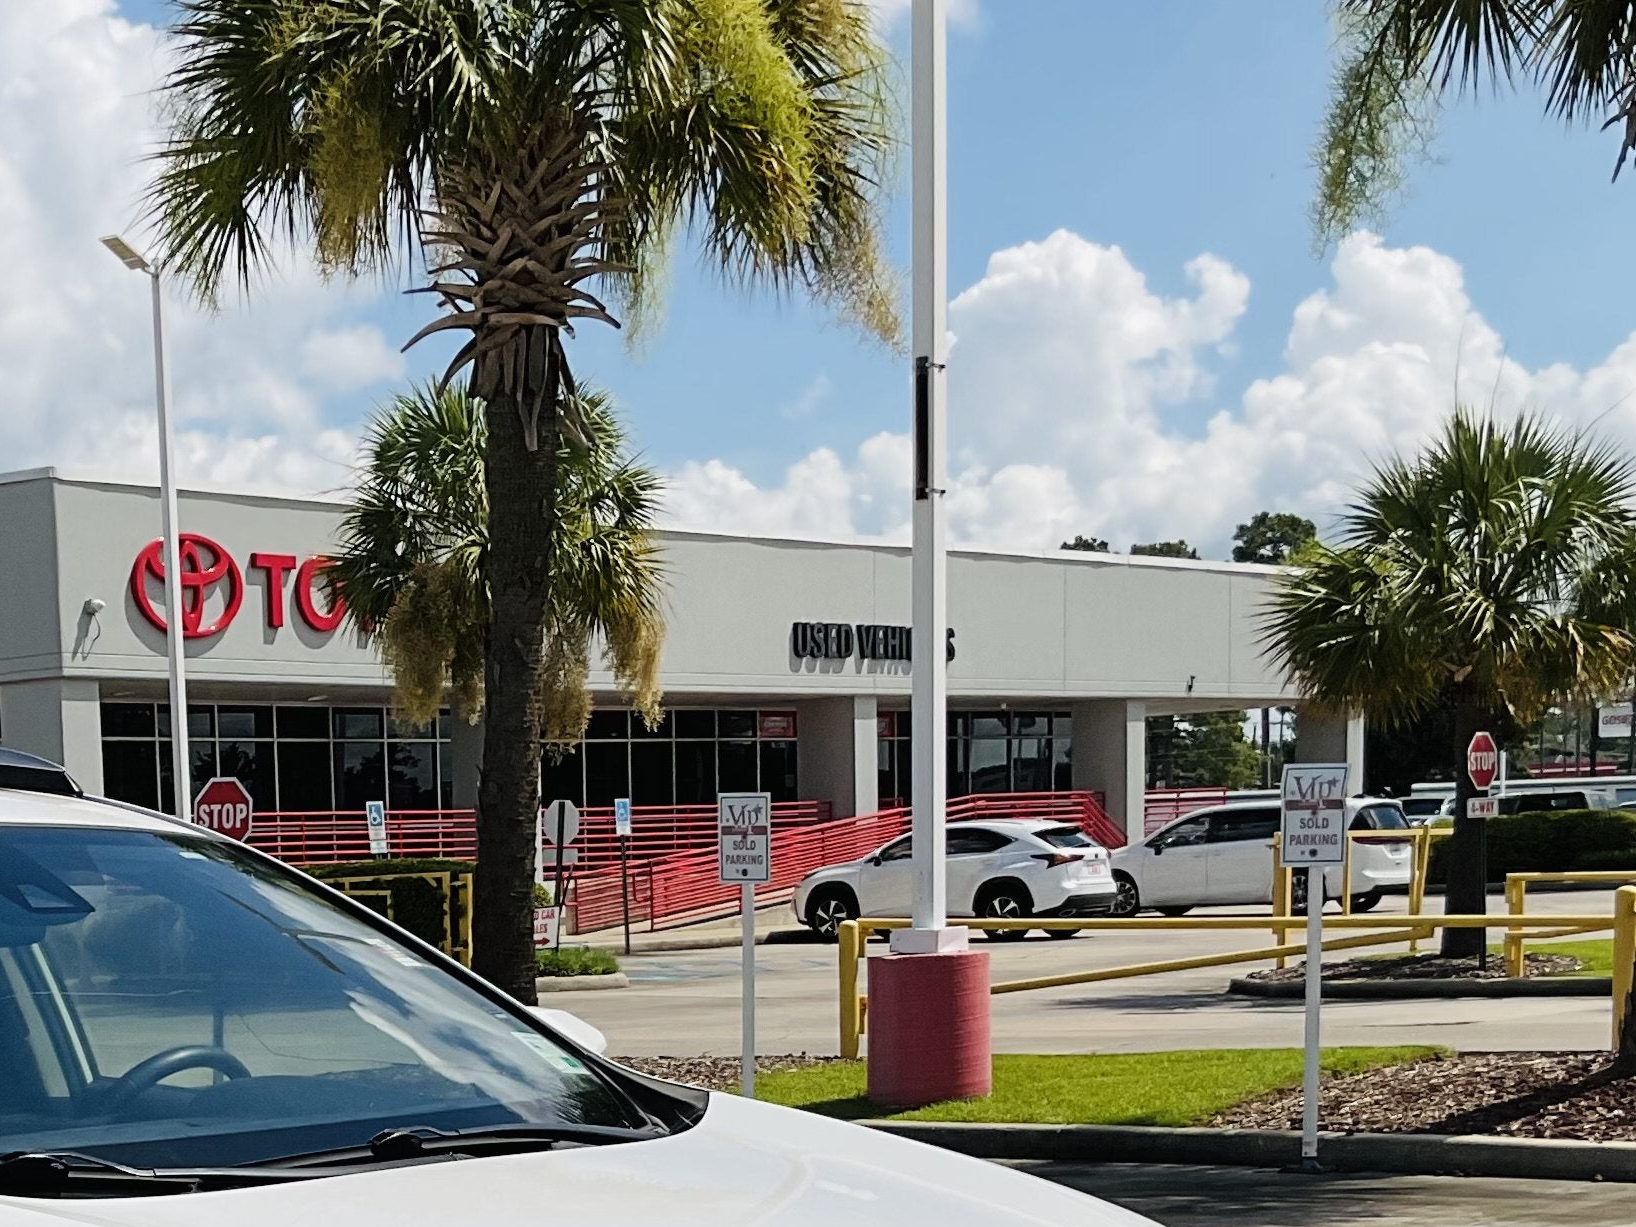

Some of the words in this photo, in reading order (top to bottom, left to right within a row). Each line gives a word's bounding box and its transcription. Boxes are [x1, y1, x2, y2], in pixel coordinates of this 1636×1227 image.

[251, 552, 349, 632] TO
[792, 621, 854, 659] USED
[856, 624, 956, 662] VEHIS
[1470, 751, 1495, 771] STOP
[198, 803, 248, 829] STOP
[1299, 817, 1329, 829] SOLD
[732, 840, 756, 850] SOLD
[1289, 833, 1338, 846] PARKING
[725, 854, 763, 865] PARKING
